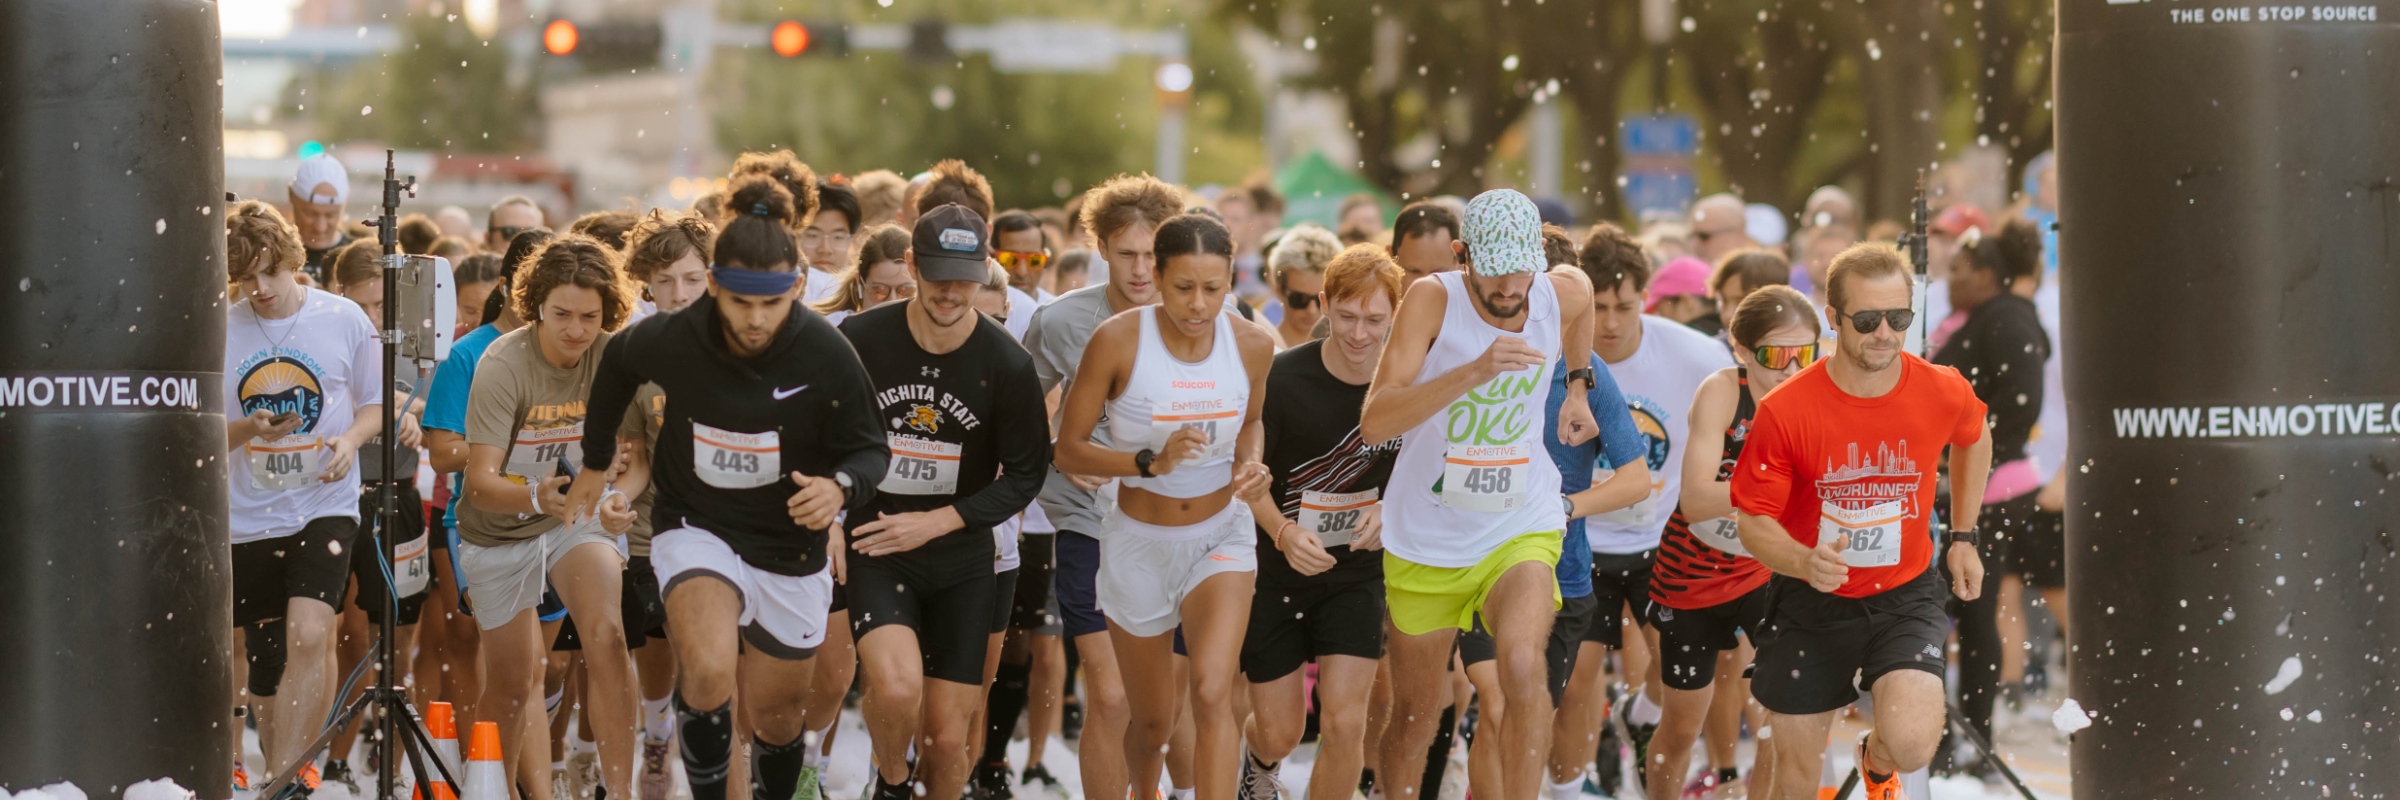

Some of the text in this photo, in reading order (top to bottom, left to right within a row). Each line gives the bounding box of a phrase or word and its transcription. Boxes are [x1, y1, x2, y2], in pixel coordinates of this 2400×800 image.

[2170, 6, 2377, 23] THE ONE STOP SOURCE
[236, 346, 326, 379] DOWN SYNDROME
[1171, 380, 1216, 389] saucony
[939, 392, 981, 431] STATE
[1447, 401, 1531, 446] OKC
[265, 452, 304, 475] 404
[535, 443, 569, 463] 114
[711, 448, 759, 474] 443
[894, 456, 938, 481] 475
[1463, 466, 1512, 494] 458
[1317, 509, 1360, 533] 382
